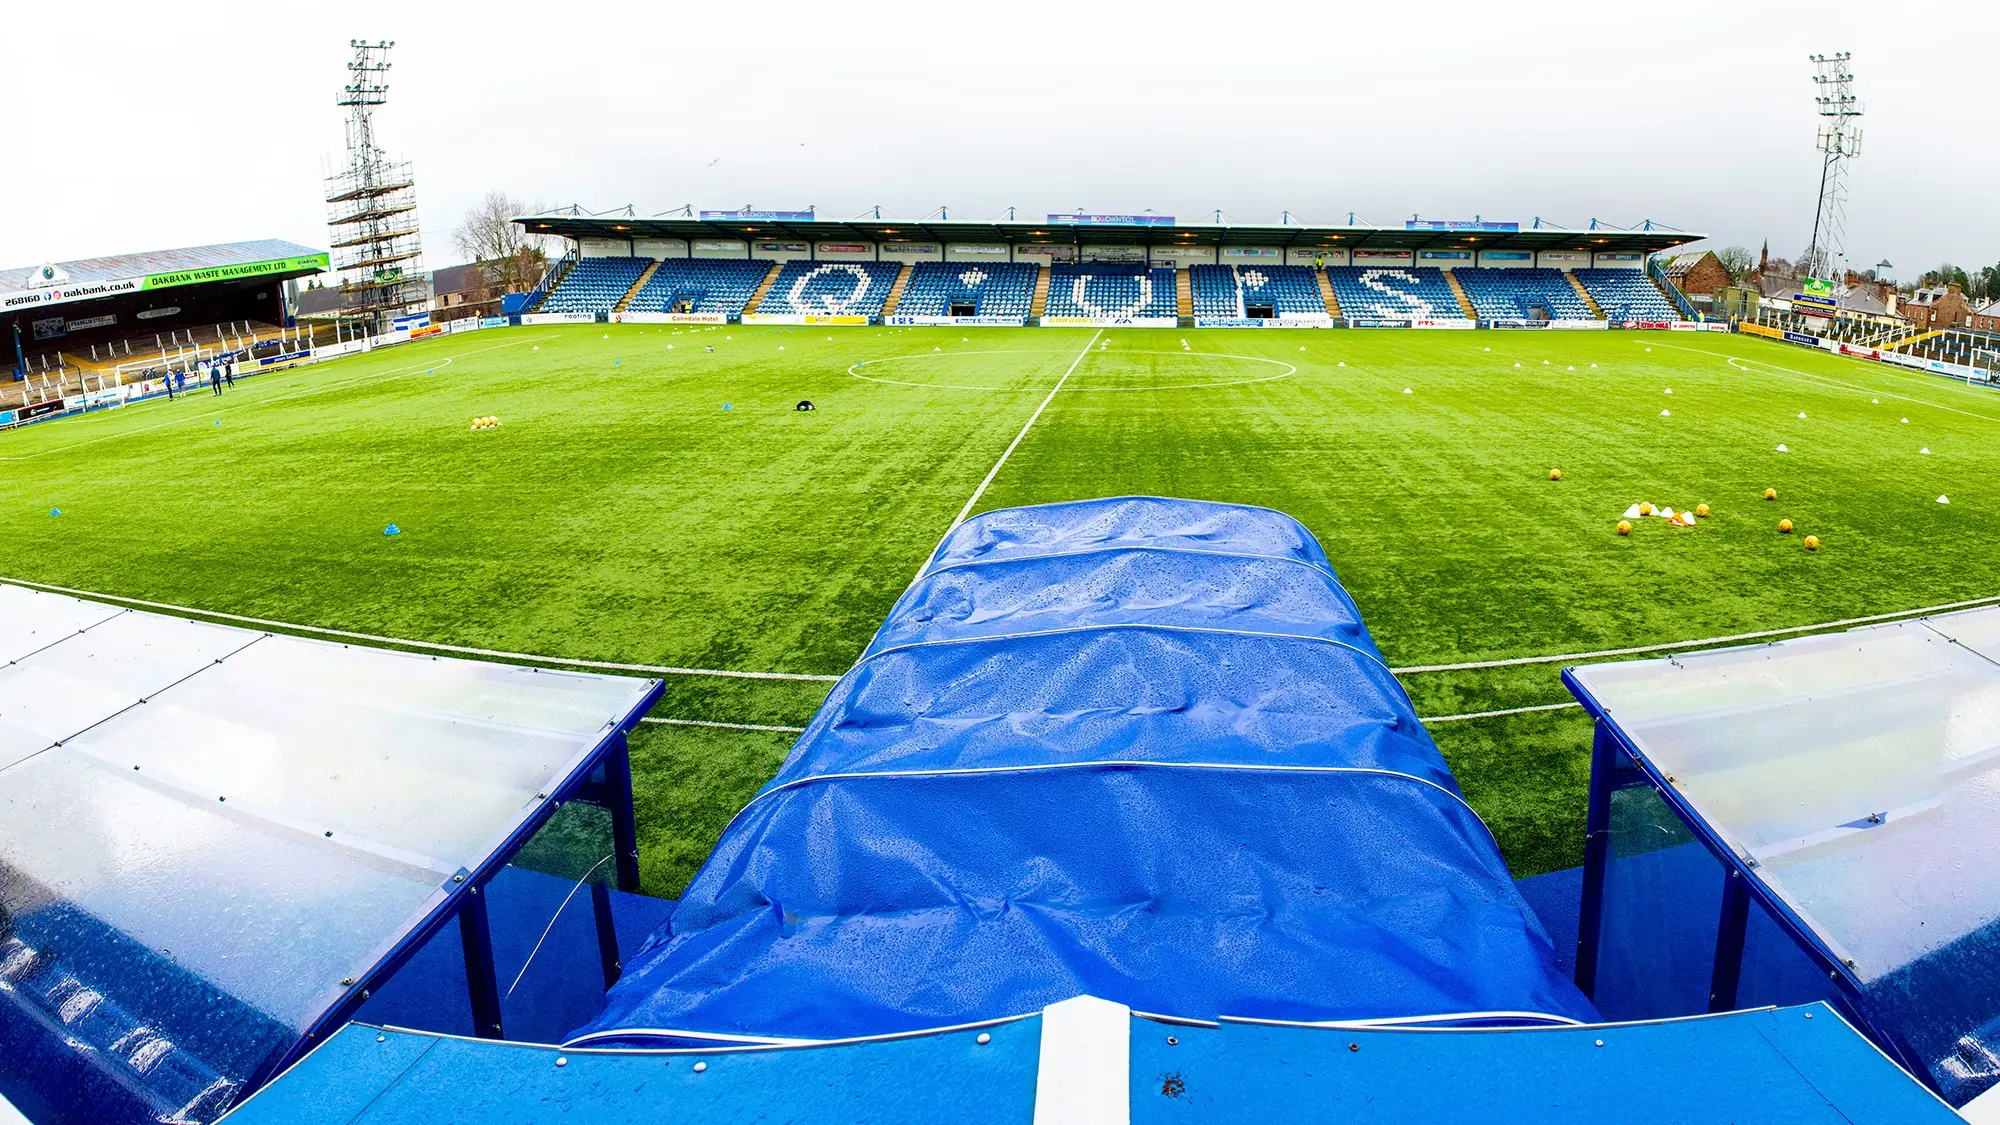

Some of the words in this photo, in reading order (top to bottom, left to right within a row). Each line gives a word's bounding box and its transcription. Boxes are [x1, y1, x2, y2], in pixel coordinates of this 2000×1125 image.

[152, 274, 192, 286] OAKBANK
[194, 270, 220, 280] WASTE
[222, 264, 272, 277] MANAGEMENT
[274, 261, 287, 270] LTD
[5, 294, 41, 307] 268160
[63, 281, 135, 298] oakbank.co.uk
